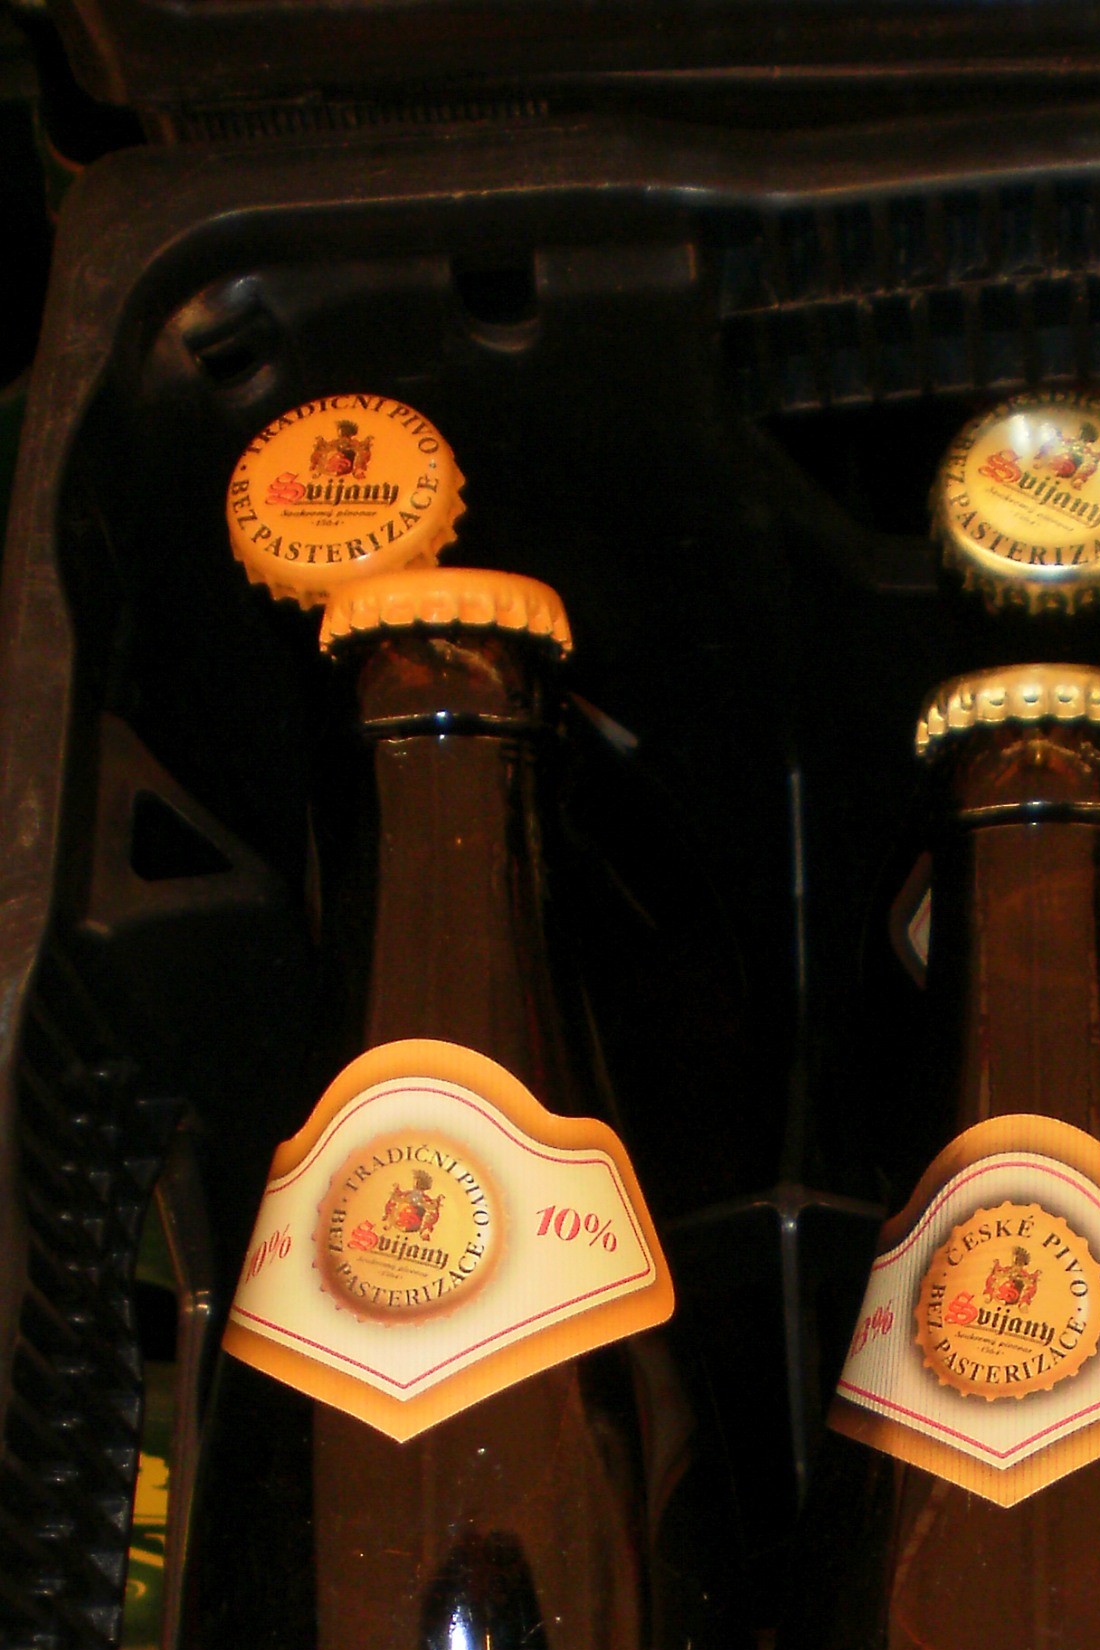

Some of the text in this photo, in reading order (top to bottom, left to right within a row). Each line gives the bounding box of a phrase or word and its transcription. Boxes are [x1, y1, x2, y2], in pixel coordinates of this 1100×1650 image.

[389, 405, 440, 455] PIVO
[231, 473, 440, 565] BEZ PASTERIZACE
[265, 471, 400, 507] Svijany
[344, 1143, 491, 1228] TRADIČNÍ PIVO
[346, 1219, 450, 1271] Svijany
[536, 1203, 619, 1254] 10%
[946, 1214, 1090, 1299] ČESKÉ PIVO
[336, 1240, 487, 1309] PASTERIZACE
[924, 1281, 1089, 1385] BEZ PASTERIZACE
[943, 1289, 1056, 1348] Svijany
